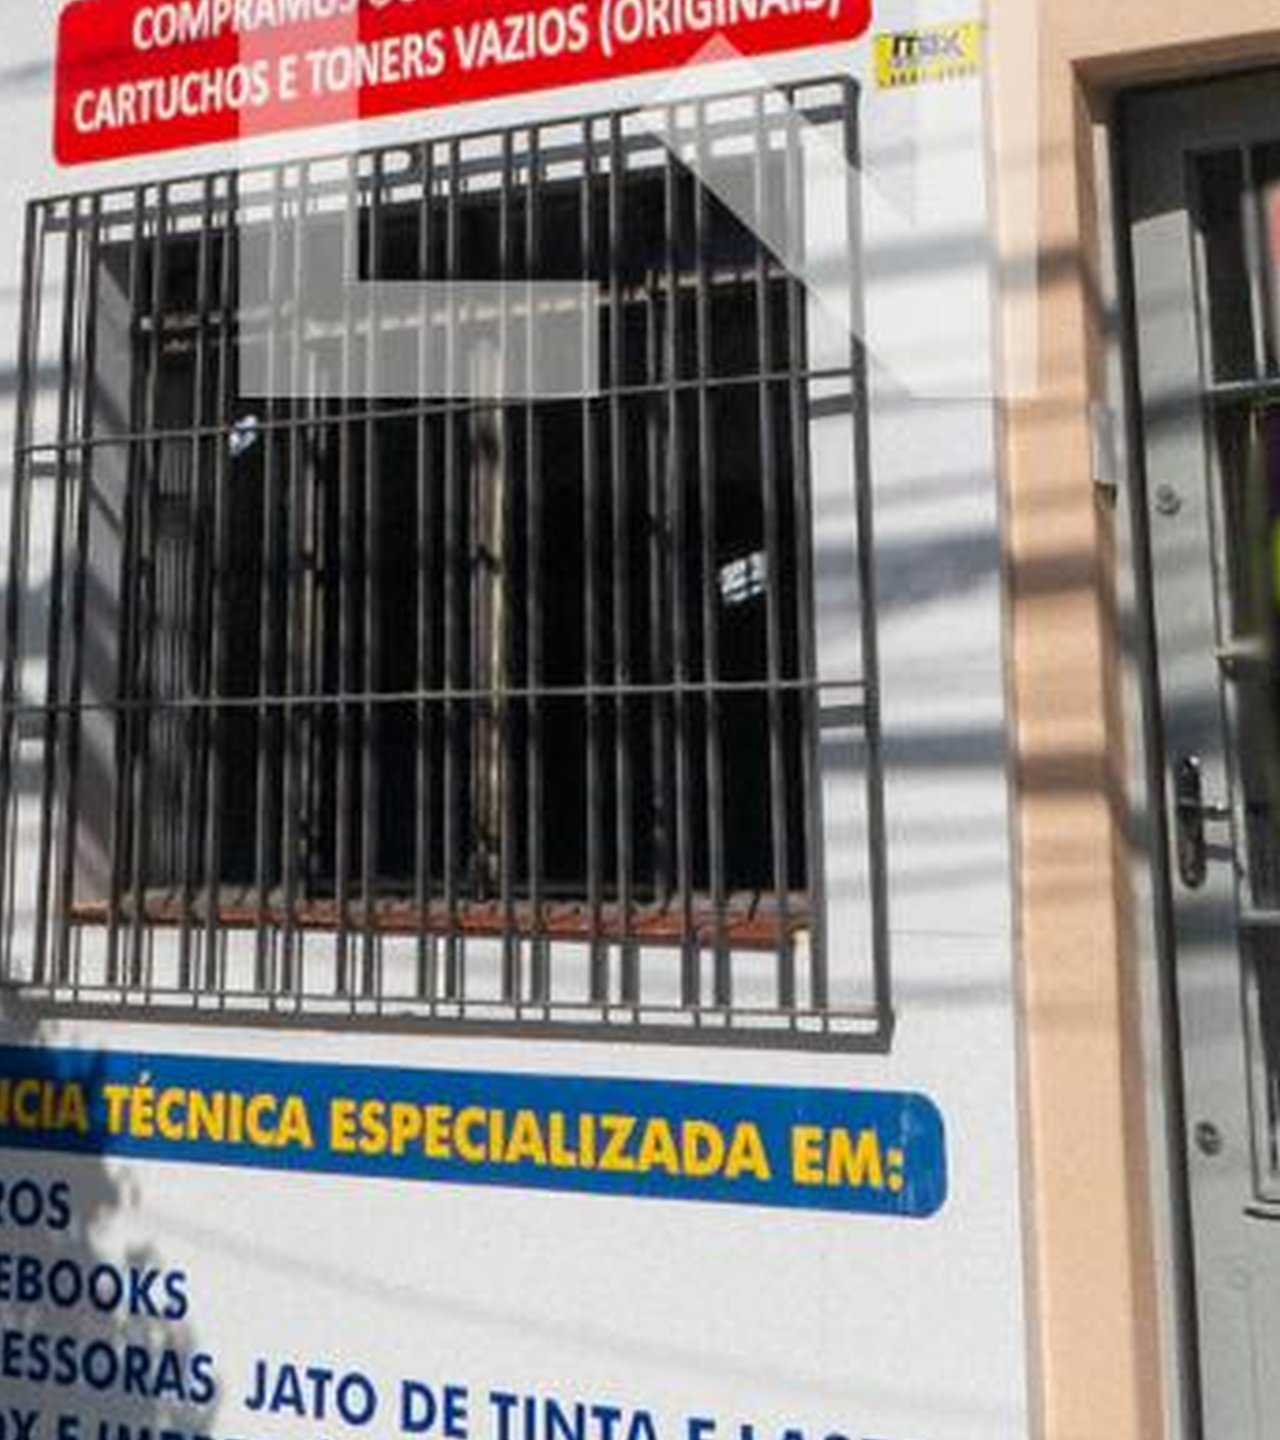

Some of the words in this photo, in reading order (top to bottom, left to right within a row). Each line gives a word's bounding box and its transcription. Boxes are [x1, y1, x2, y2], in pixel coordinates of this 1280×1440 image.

[73, 60, 268, 134] CARTUCHOS
[278, 54, 299, 101] E
[306, 28, 446, 92] TONERS
[454, 3, 589, 70] VAZIOS
[102, 1071, 315, 1149] TÉCNICA
[329, 1097, 773, 1181] ESPECIALIZADA
[790, 1124, 905, 1193] EM:
[245, 1359, 378, 1426] JATO
[399, 1378, 469, 1440] DE
